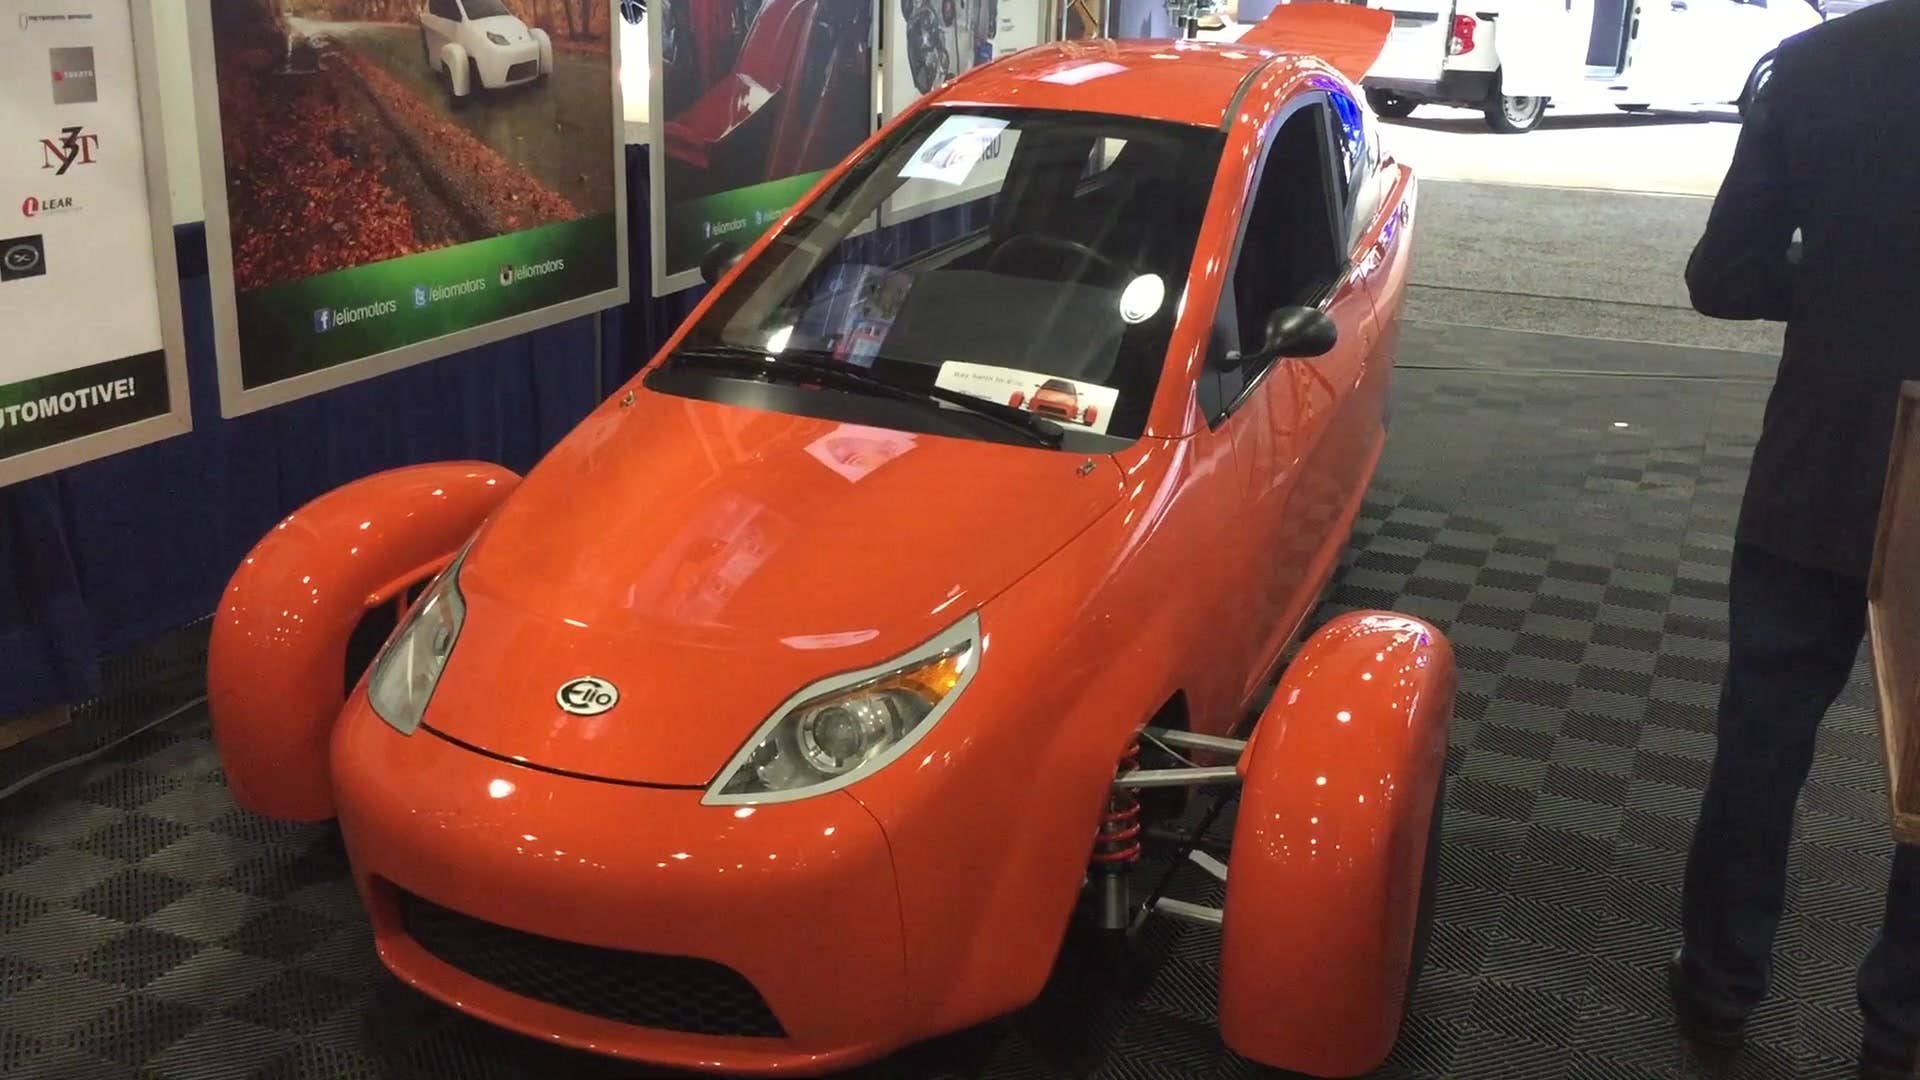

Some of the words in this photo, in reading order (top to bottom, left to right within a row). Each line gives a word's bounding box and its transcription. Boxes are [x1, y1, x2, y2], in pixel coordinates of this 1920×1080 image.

[42, 197, 73, 211] LEAR
[512, 258, 564, 281] /eliomotors
[429, 277, 486, 302] /eliomotors
[332, 299, 397, 327] /eliomotors
[561, 680, 612, 708] Elio
